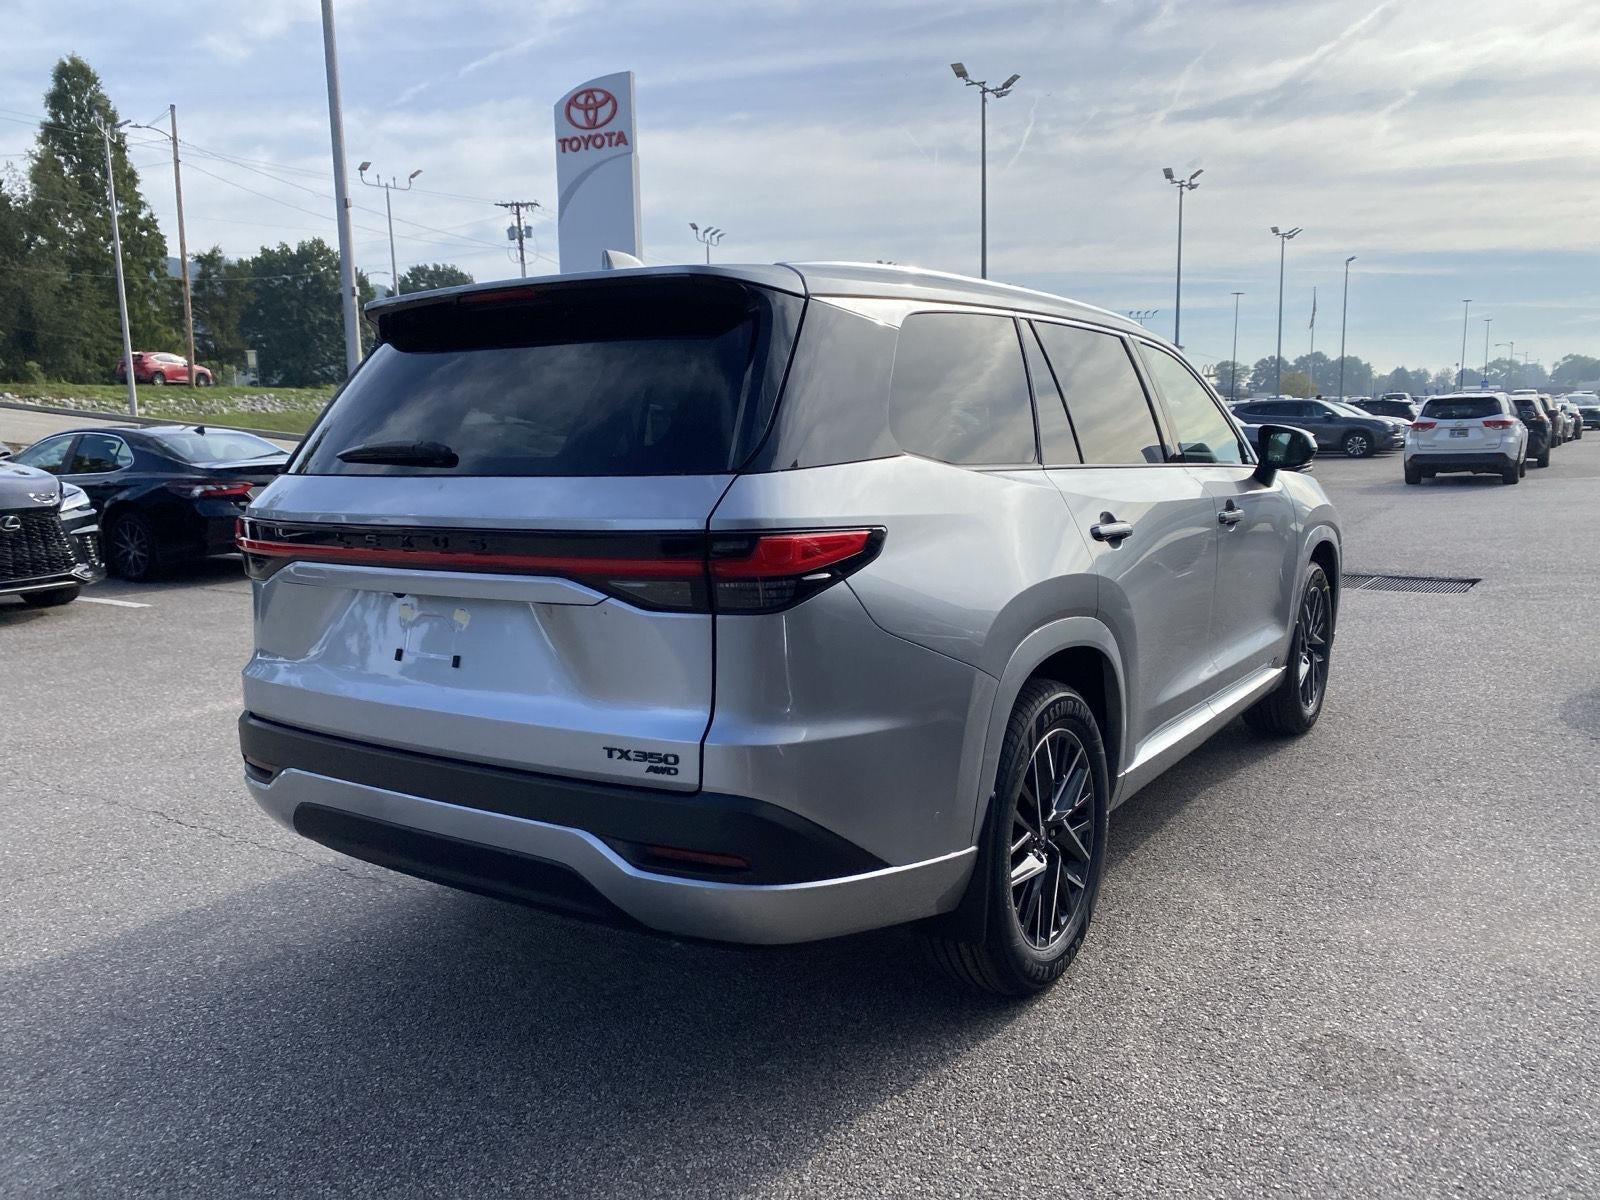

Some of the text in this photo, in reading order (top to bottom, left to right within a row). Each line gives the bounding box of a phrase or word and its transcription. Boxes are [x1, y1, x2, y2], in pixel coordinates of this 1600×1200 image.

[558, 130, 628, 154] TOYOTA
[335, 531, 488, 550] LEXUS
[602, 746, 680, 766] TX350
[645, 765, 679, 776] AWD
